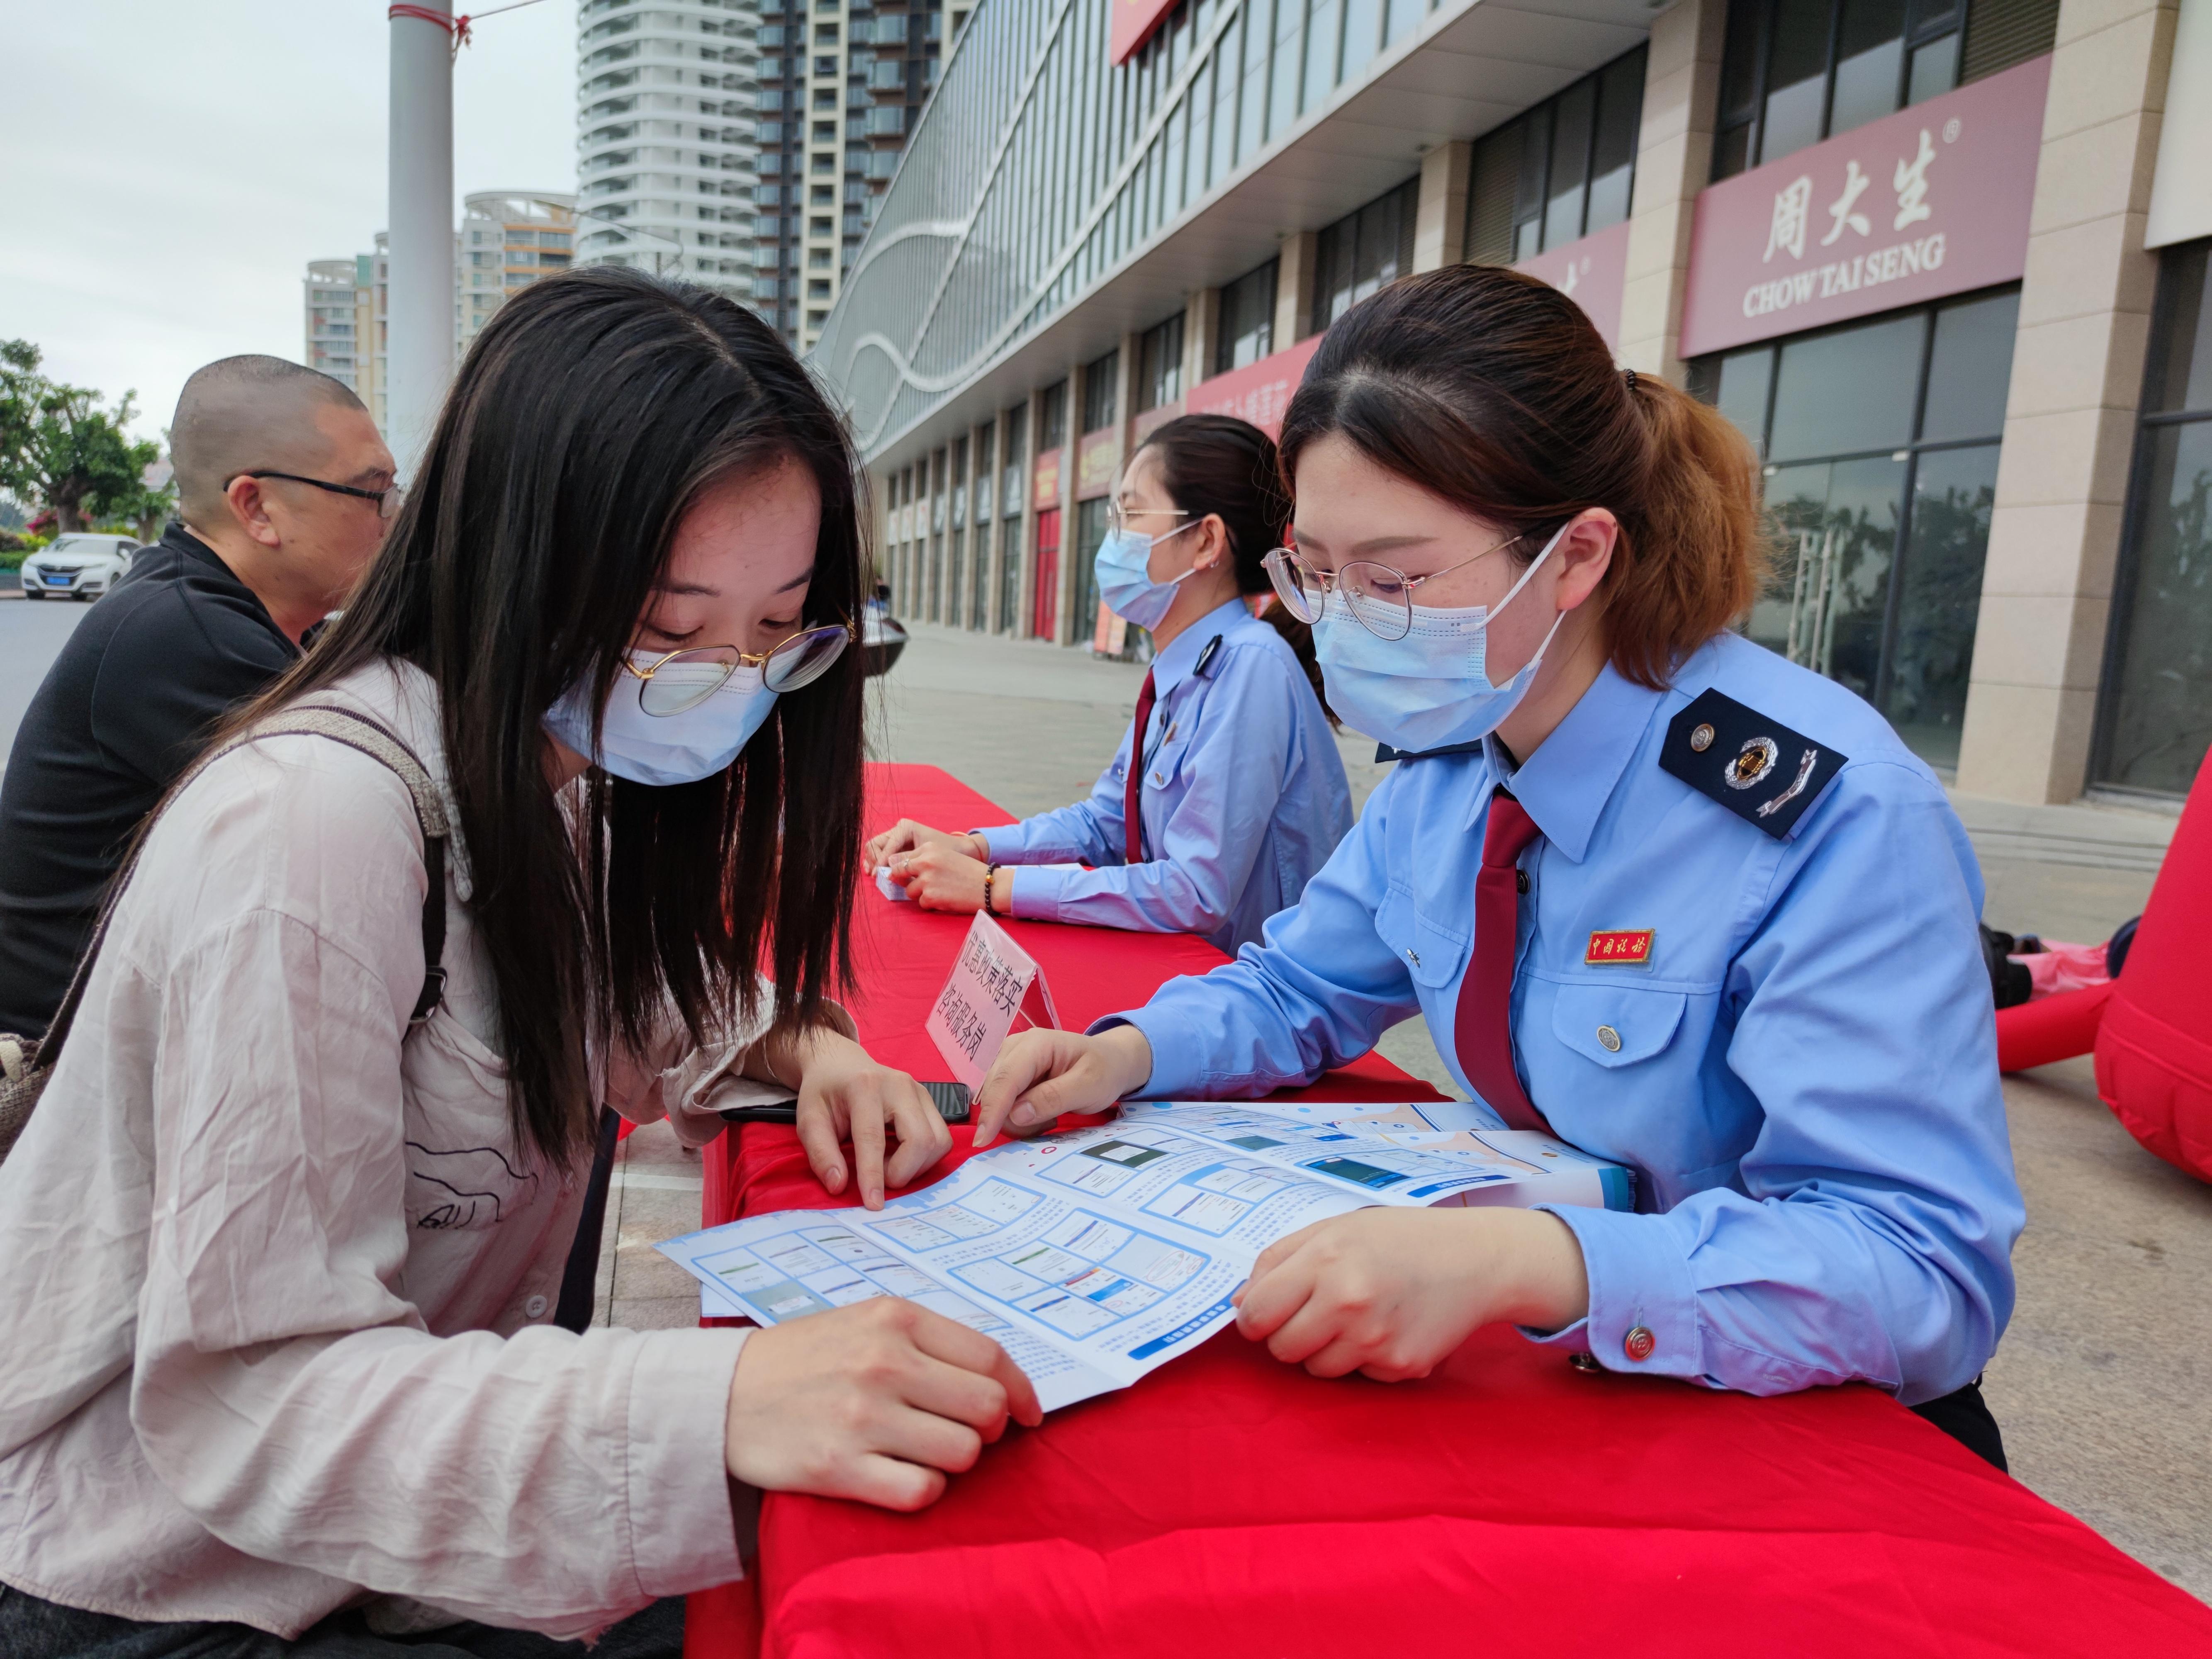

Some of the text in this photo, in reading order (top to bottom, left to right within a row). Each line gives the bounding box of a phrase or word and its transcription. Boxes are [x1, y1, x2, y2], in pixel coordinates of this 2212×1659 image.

[1762, 128, 1936, 263] 周大生
[1743, 232, 1946, 318] CHOW TAI SENG
[961, 930, 1023, 1017] 优惠政策落实
[936, 982, 987, 1062] 咨询服务岗
